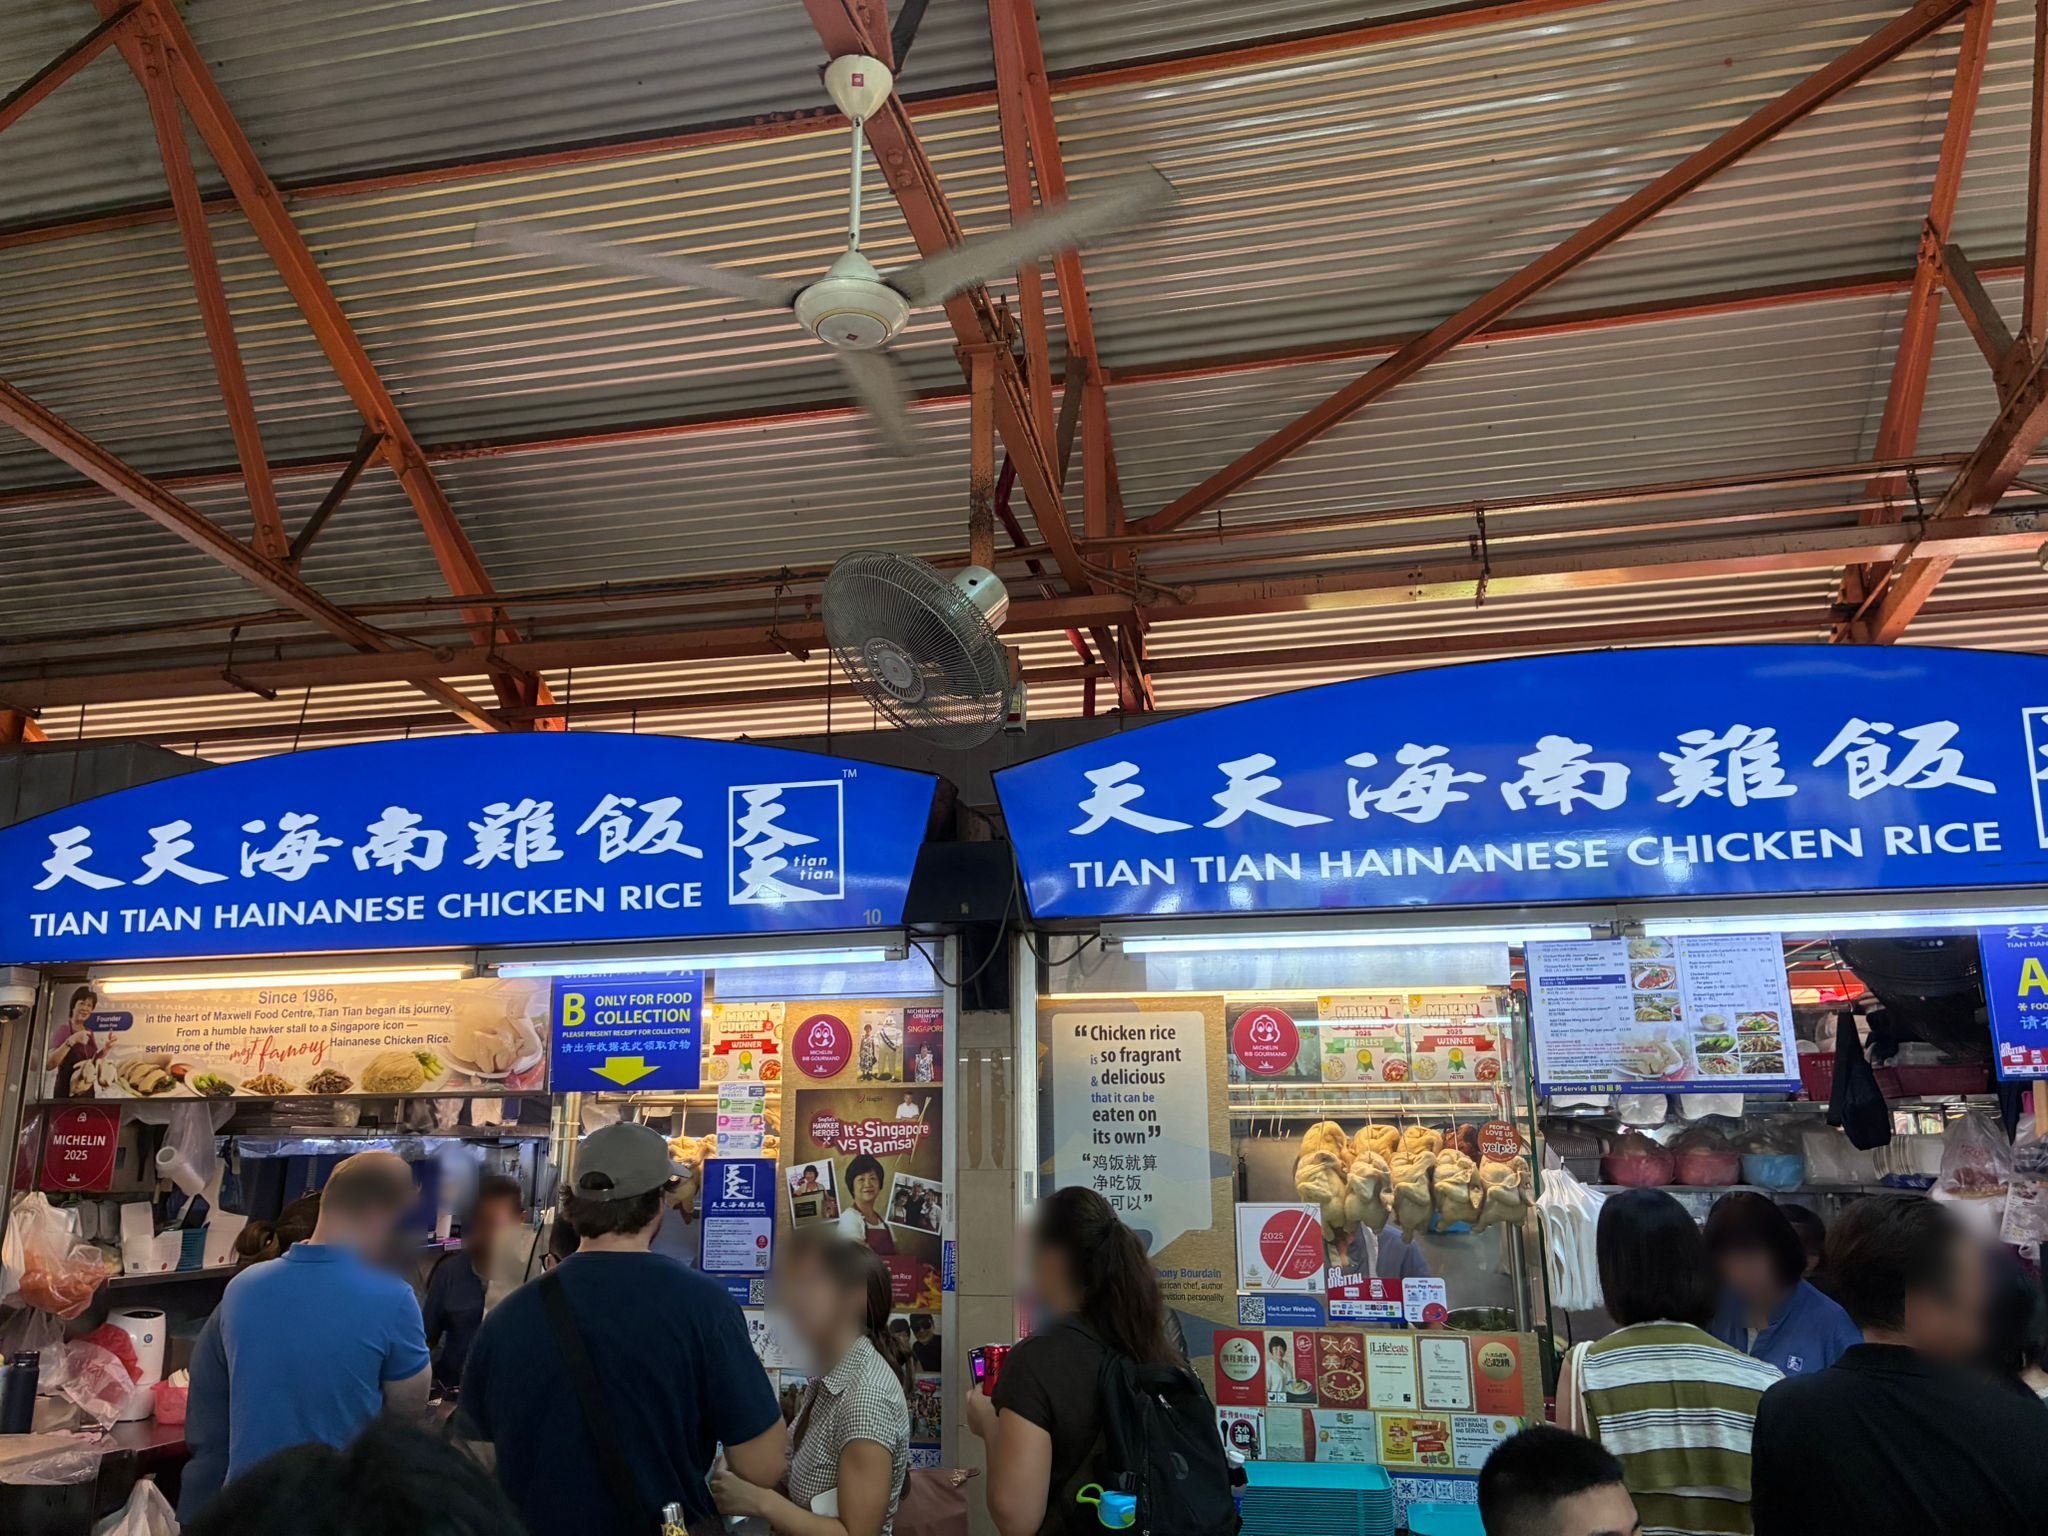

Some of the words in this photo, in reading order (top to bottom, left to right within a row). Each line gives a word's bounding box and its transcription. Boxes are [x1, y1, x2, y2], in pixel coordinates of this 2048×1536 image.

[842, 769, 857, 778] TM
[1068, 717, 1997, 835] 天天海南雞飯
[33, 793, 703, 891] 天天海南雞飯
[794, 855, 827, 867] tian
[1070, 859, 1175, 889] TIAN
[1191, 853, 1301, 883] TIAN
[1319, 840, 1609, 880] HAINANESE
[1627, 828, 1864, 867] CHICKEN
[1884, 822, 2002, 856] RICE
[800, 868, 834, 880] tian
[30, 911, 108, 937] TIAN
[120, 906, 201, 933] TIAN
[214, 895, 425, 929] HAINANESE
[437, 887, 605, 919] CHICKEN
[620, 882, 702, 911] RICE
[863, 909, 882, 925] 10
[259, 990, 297, 1004] Since
[303, 989, 337, 1003] 1986,
[594, 995, 627, 1007] ONLY
[630, 993, 653, 1005] FOR
[657, 992, 693, 1004] FOOD
[146, 1014, 154, 1023] in
[157, 1013, 172, 1023] the
[174, 1012, 199, 1022] heart
[201, 1011, 212, 1021] of
[214, 1010, 252, 1021] Maxwell
[254, 1009, 279, 1019] Food
[281, 1008, 316, 1019] Centre,
[319, 1007, 339, 1017] Tian
[342, 1006, 362, 1016] Tian
[365, 1006, 396, 1017] began
[399, 1005, 411, 1014] its
[413, 1004, 453, 1016] journey.
[563, 993, 586, 1027] B
[594, 1008, 691, 1025] COLLECTION
[177, 1027, 201, 1037] From
[212, 1025, 247, 1036] humble
[249, 1025, 283, 1035] hawker
[286, 1023, 307, 1033] stall
[309, 1023, 319, 1032] to
[330, 1021, 380, 1033] Singapore
[383, 1021, 404, 1030] icon
[652, 1027, 691, 1035] COLLECTION
[1150, 1024, 1176, 1040] rice
[146, 1044, 180, 1054] serving
[183, 1044, 201, 1052] one
[203, 1042, 213, 1051] of
[215, 1041, 230, 1051] the
[330, 1036, 381, 1047] Hainanese
[384, 1034, 424, 1045] Chicken
[427, 1033, 452, 1044] Rice.
[1436, 1037, 1475, 1045] WINNER
[259, 1035, 330, 1072] famous
[1090, 1054, 1098, 1065] is
[1101, 1051, 1116, 1063] so
[1119, 1047, 1182, 1066] fragrant
[1091, 1076, 1098, 1087] &
[1101, 1069, 1166, 1085] delicious
[1091, 1093, 1112, 1103] that
[1114, 1093, 1122, 1103] it
[1123, 1095, 1140, 1103] can
[1142, 1092, 1155, 1103] be
[1093, 1108, 1135, 1122] eaten
[1139, 1109, 1157, 1122] on
[843, 1124, 864, 1137] It's
[864, 1121, 929, 1139] Singapore
[1093, 1128, 1111, 1144] its
[53, 1135, 106, 1146] MICHELIN
[64, 1150, 88, 1160] 2025
[1483, 1143, 1506, 1154] yelp
[1092, 1174, 1142, 1191] 净吃饭
[1101, 1194, 1152, 1211] 可以”
[1262, 1232, 1284, 1240] 2025
[1180, 1268, 1222, 1278] Bourdain
[1328, 1273, 1364, 1288] DIGITAL
[1201, 1282, 1223, 1290] author
